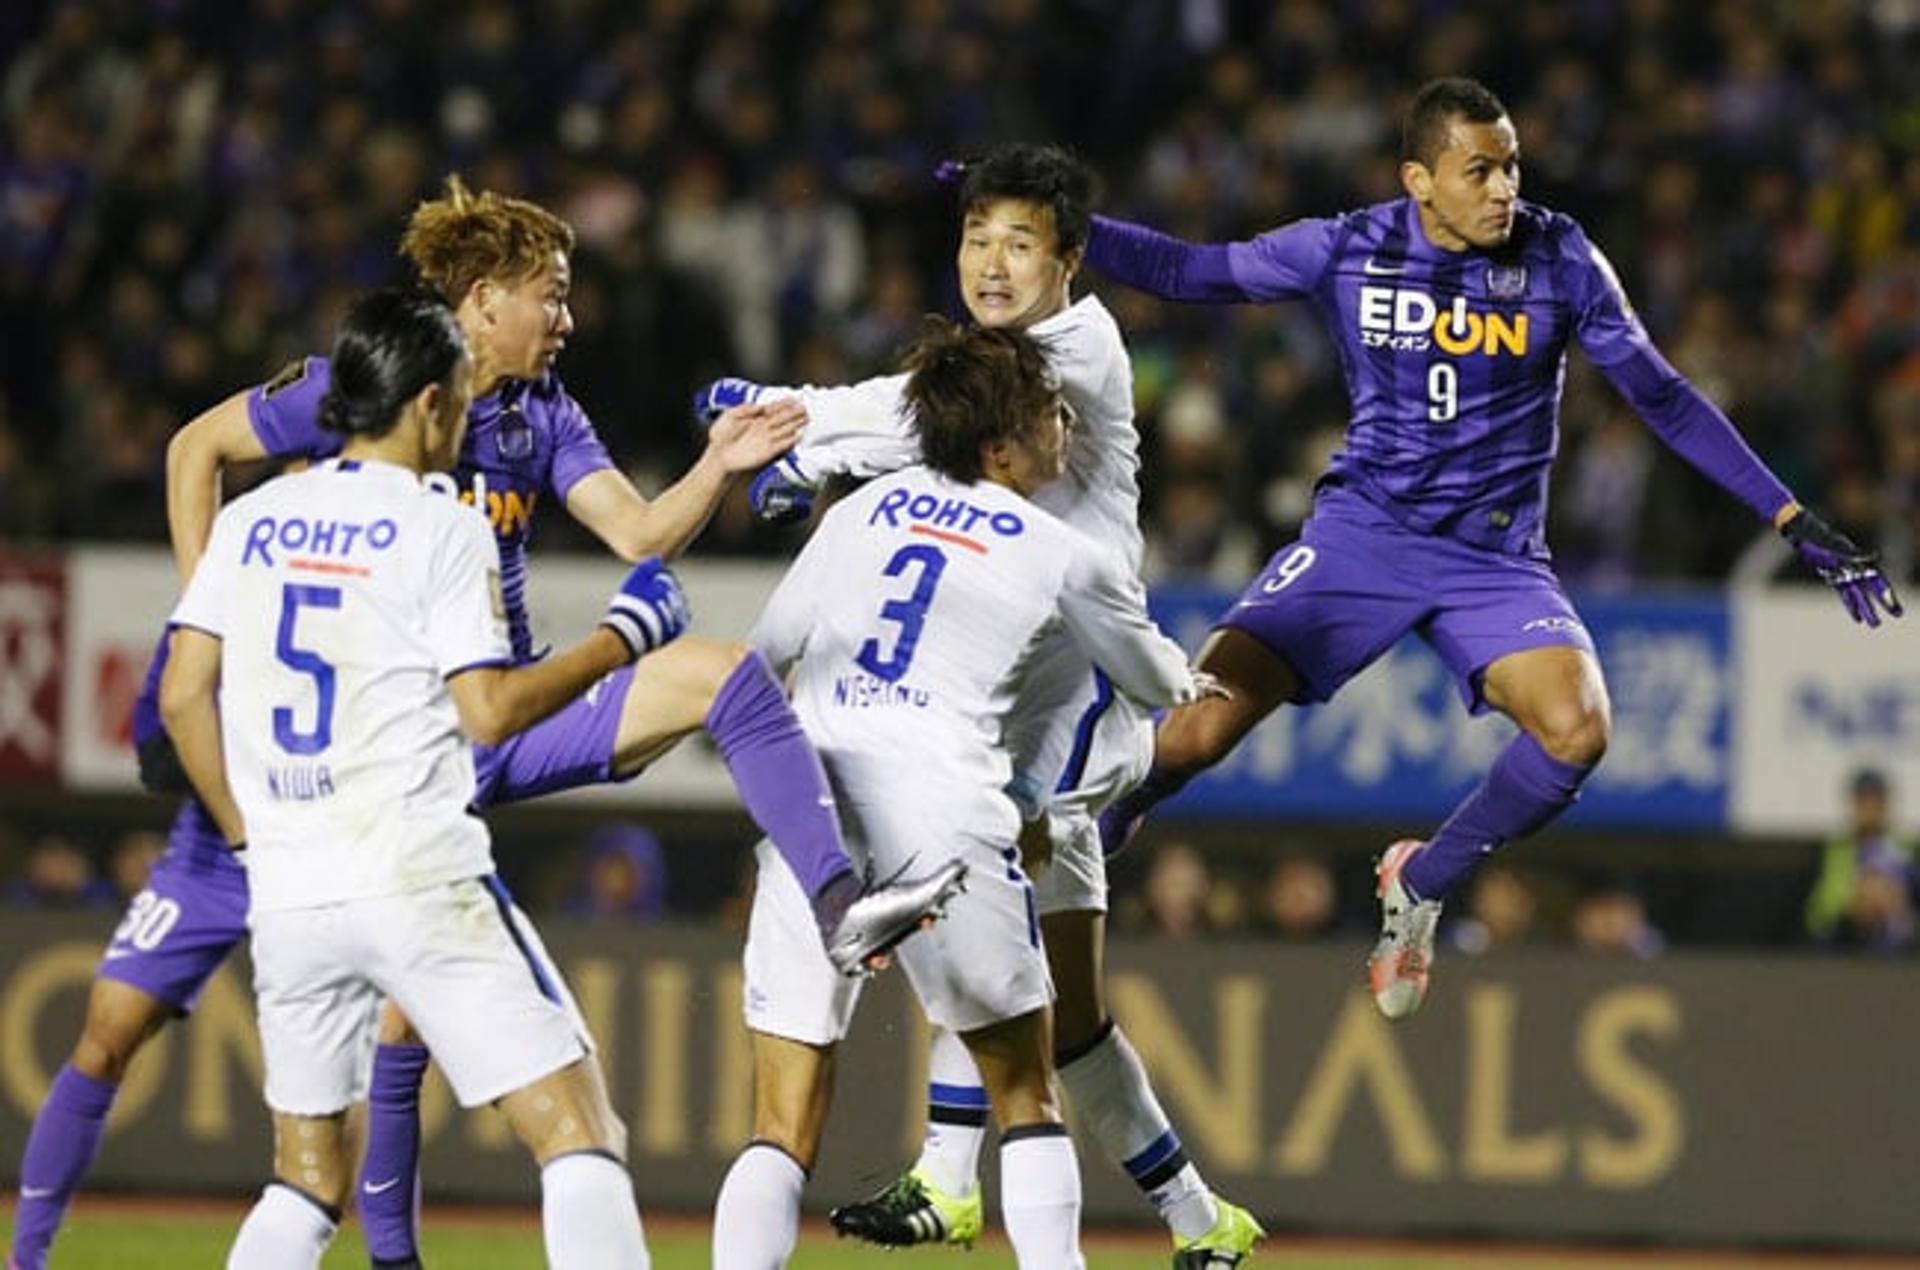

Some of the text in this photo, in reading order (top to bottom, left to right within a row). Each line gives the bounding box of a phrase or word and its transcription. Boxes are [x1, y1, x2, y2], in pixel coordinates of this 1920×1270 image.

[1360, 285, 1528, 355] EDION
[1428, 363, 1458, 422] 9
[869, 487, 1024, 536] ROHTO
[241, 516, 397, 567] ROHTO
[1264, 546, 1316, 593] 9
[854, 543, 947, 682] 3
[273, 582, 341, 756] 5
[268, 765, 335, 801] NIWA
[114, 888, 180, 950] 30
